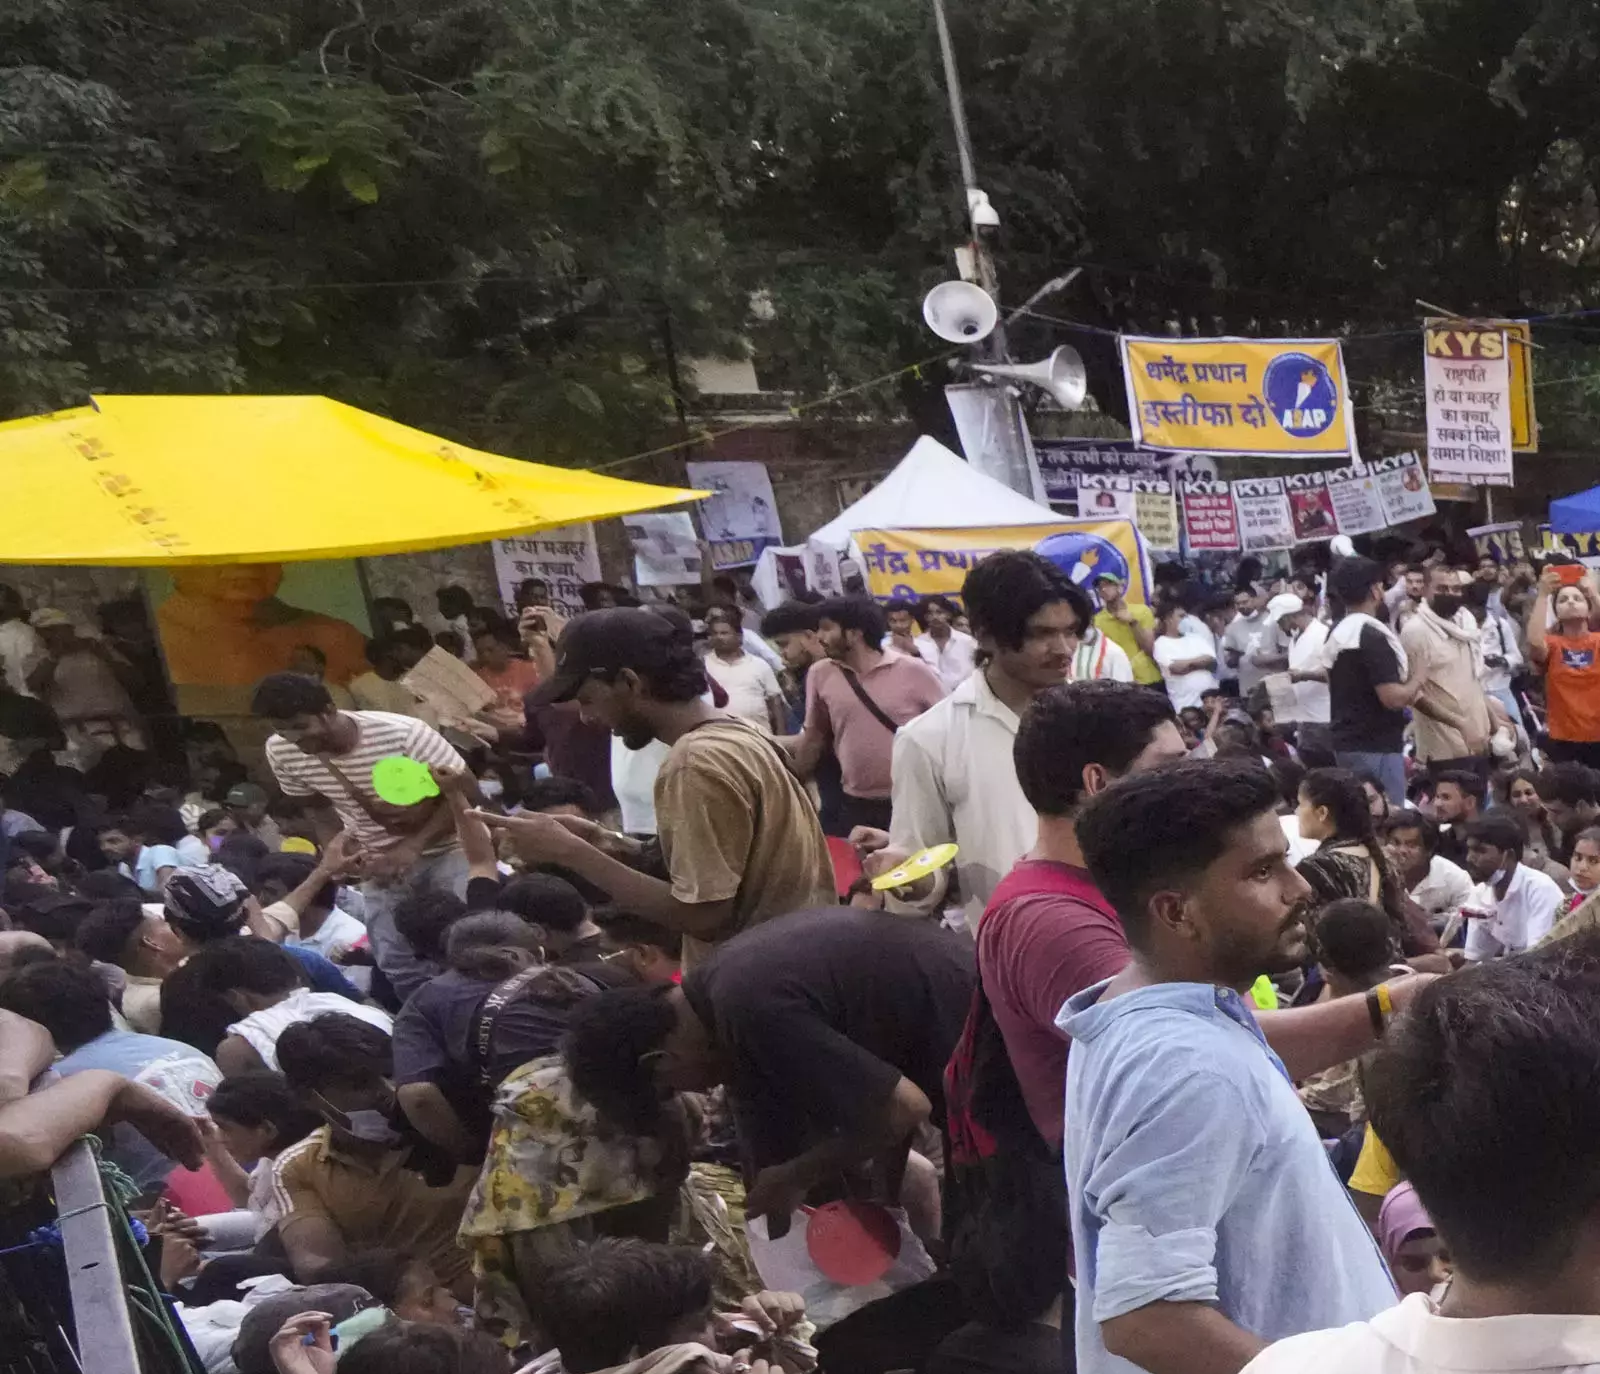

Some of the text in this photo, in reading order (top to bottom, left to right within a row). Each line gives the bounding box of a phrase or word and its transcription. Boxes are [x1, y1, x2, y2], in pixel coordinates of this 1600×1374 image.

[1427, 329, 1504, 358] KYS
[1193, 361, 1247, 383] प्रधान
[1143, 393, 1268, 429] इस्तीफा दो
[1374, 452, 1414, 471] KYS
[1081, 474, 1130, 491] KYS
[1286, 471, 1324, 489] KYS
[1328, 463, 1367, 484] KYS
[1184, 480, 1229, 495] KYS
[1238, 481, 1282, 497] KYS
